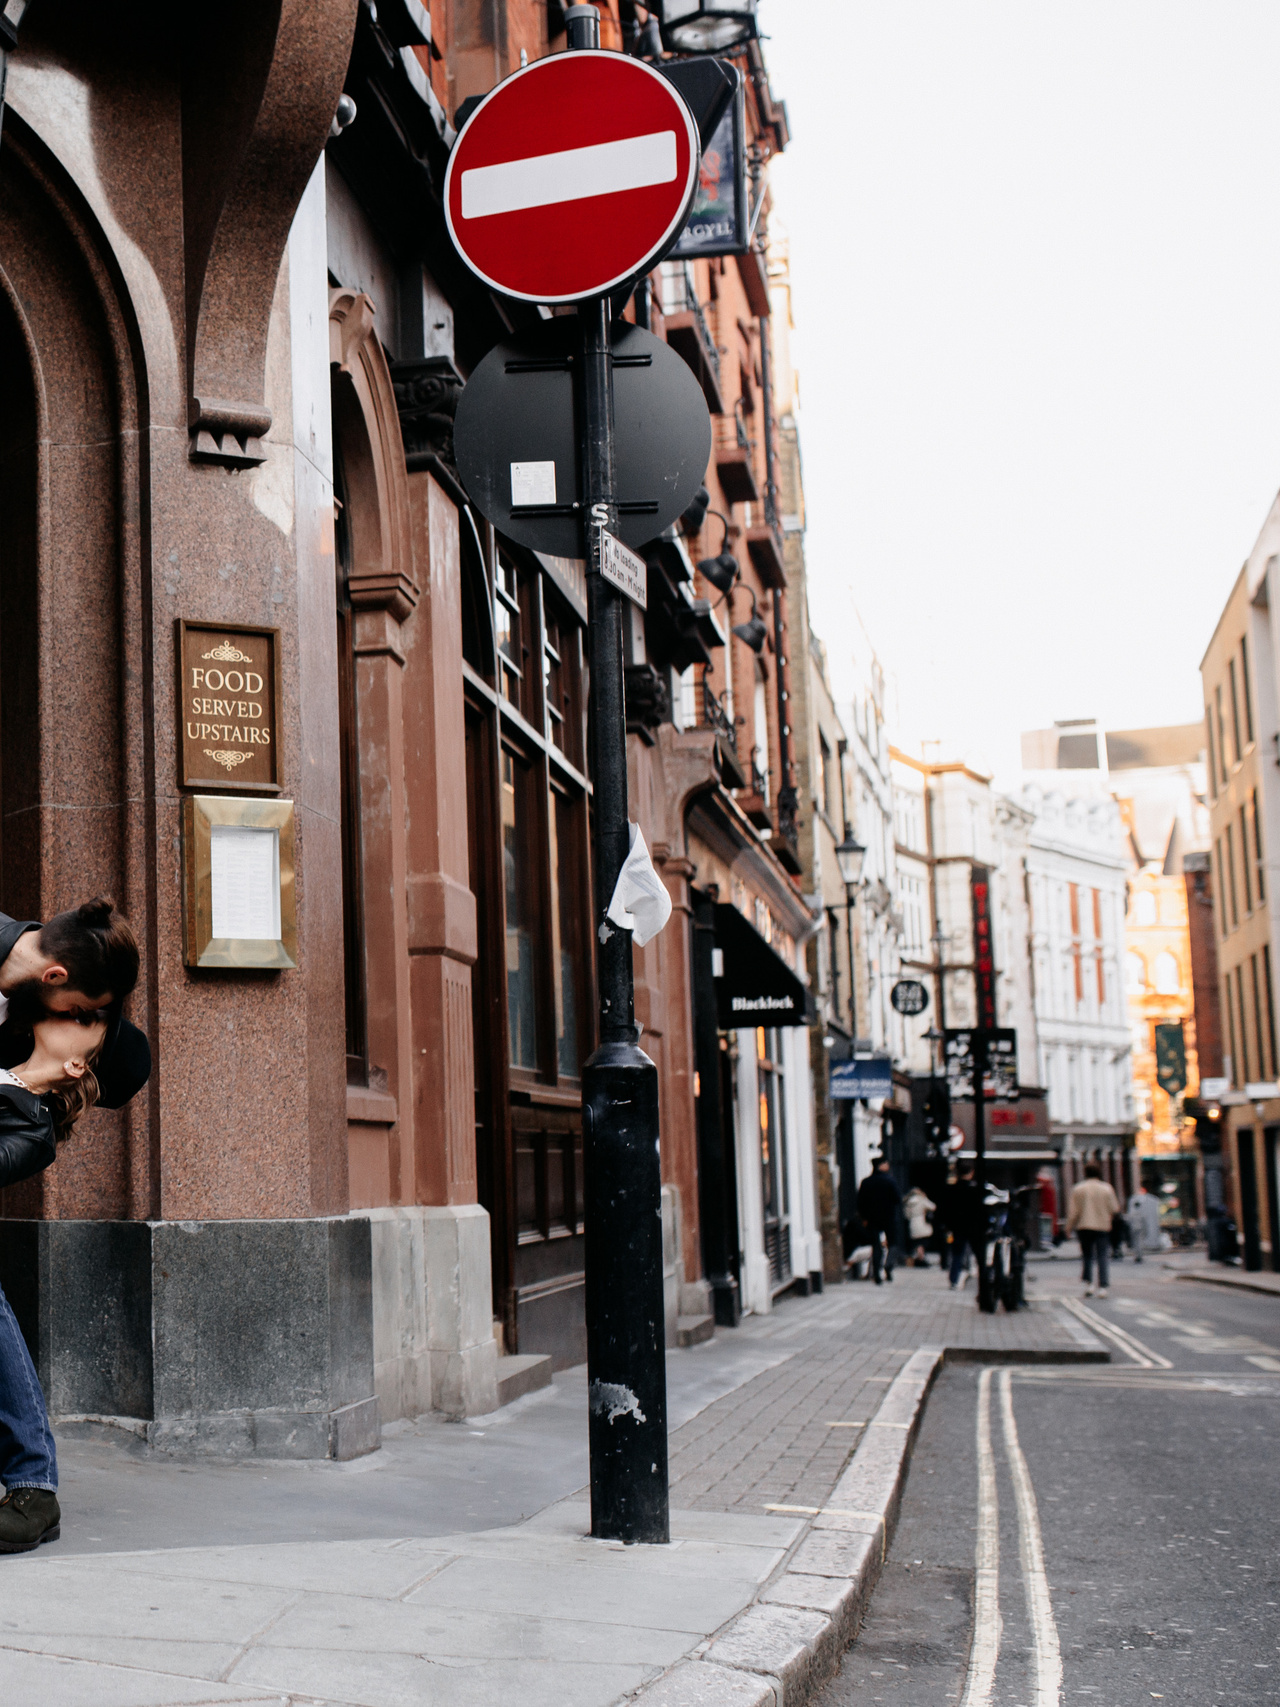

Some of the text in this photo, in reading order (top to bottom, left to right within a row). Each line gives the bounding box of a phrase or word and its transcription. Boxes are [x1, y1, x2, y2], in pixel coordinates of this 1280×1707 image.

[681, 221, 733, 240] RGYLL
[620, 549, 638, 577] loading
[617, 569, 625, 582] am
[191, 667, 264, 694] FOOD
[192, 697, 263, 719] SERVED
[186, 722, 271, 745] UPSTAIRS
[732, 995, 794, 1011] Blacklock
